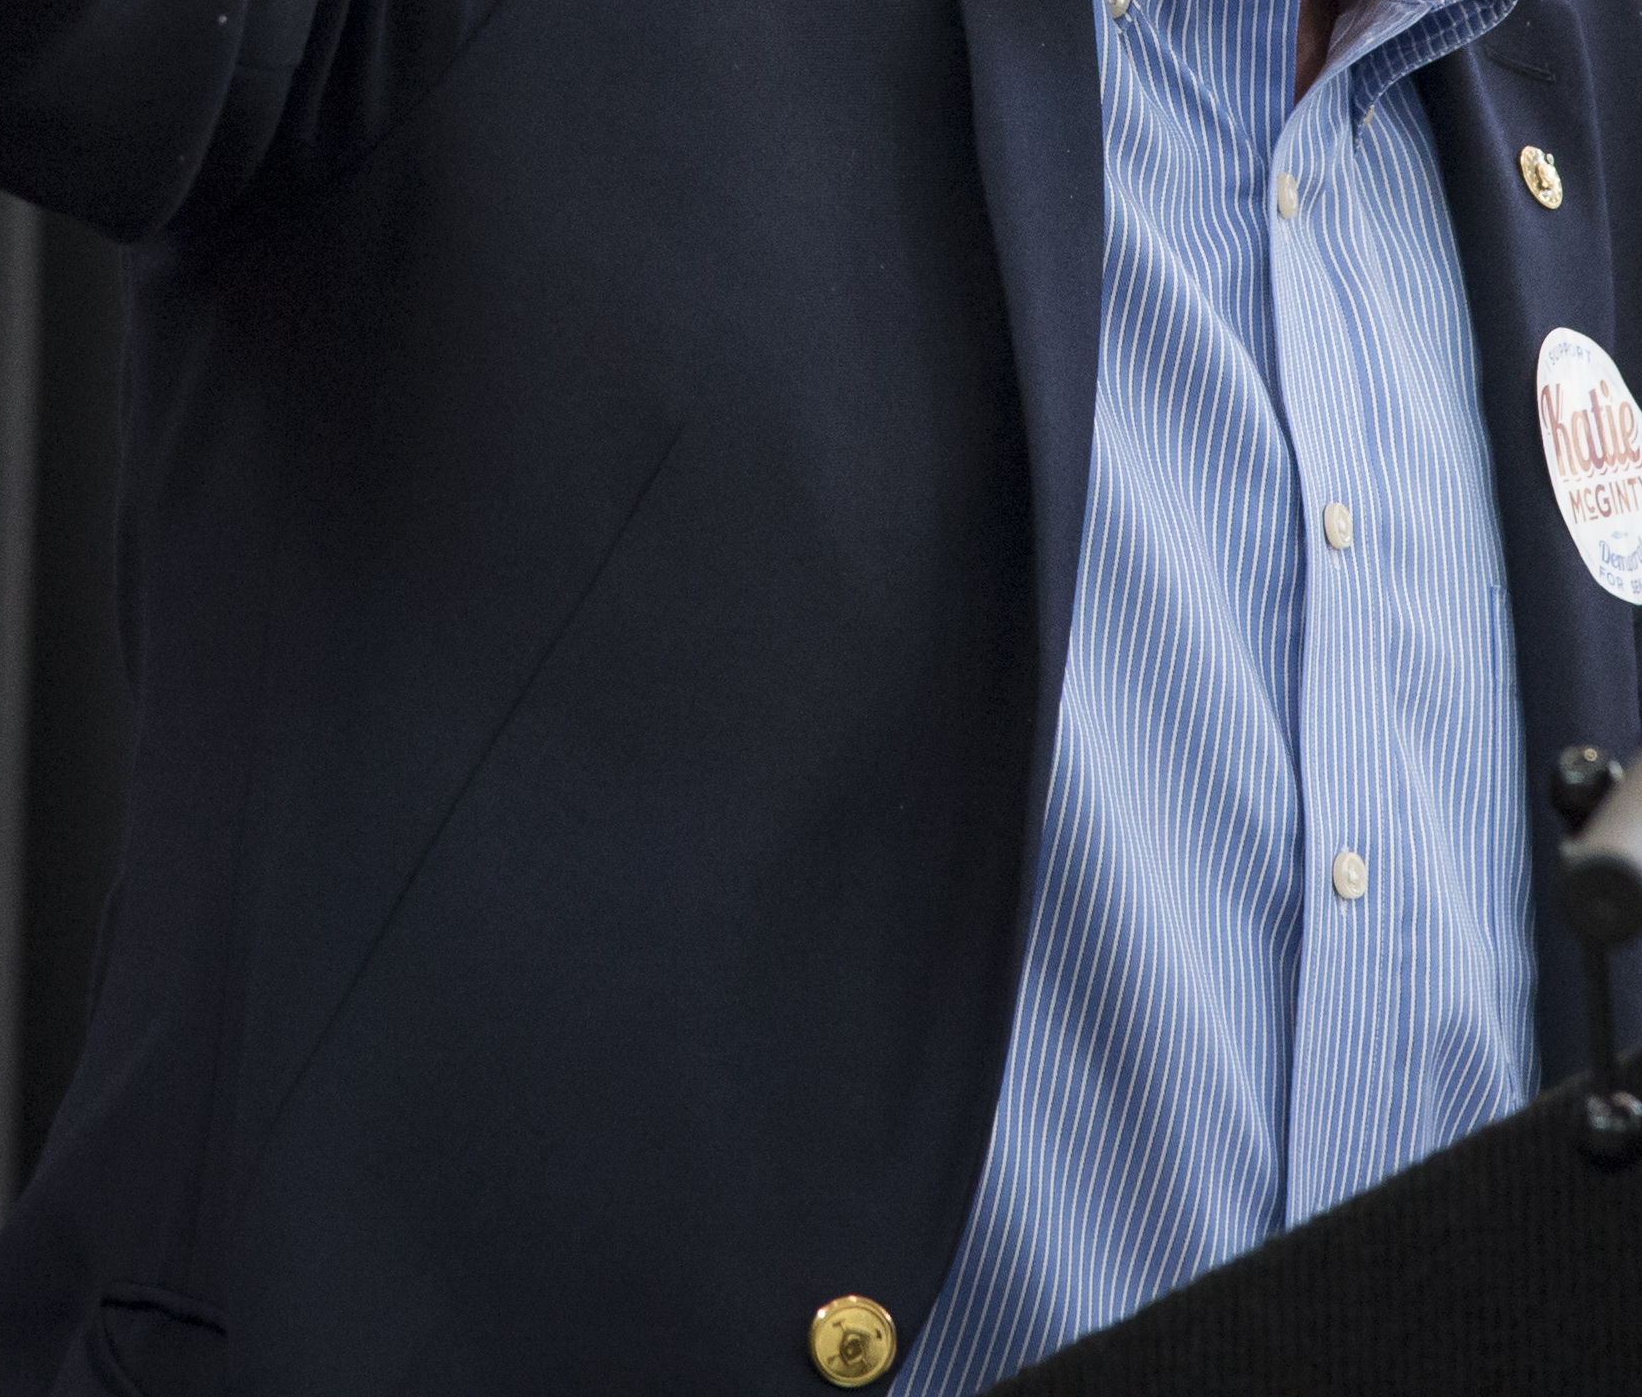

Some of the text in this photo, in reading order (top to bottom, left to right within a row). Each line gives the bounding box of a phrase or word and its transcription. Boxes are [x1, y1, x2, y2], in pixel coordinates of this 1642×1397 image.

[1548, 342, 1591, 366] SUPPORT
[1541, 380, 1642, 478] Katie
[1599, 565, 1624, 591] FOR
